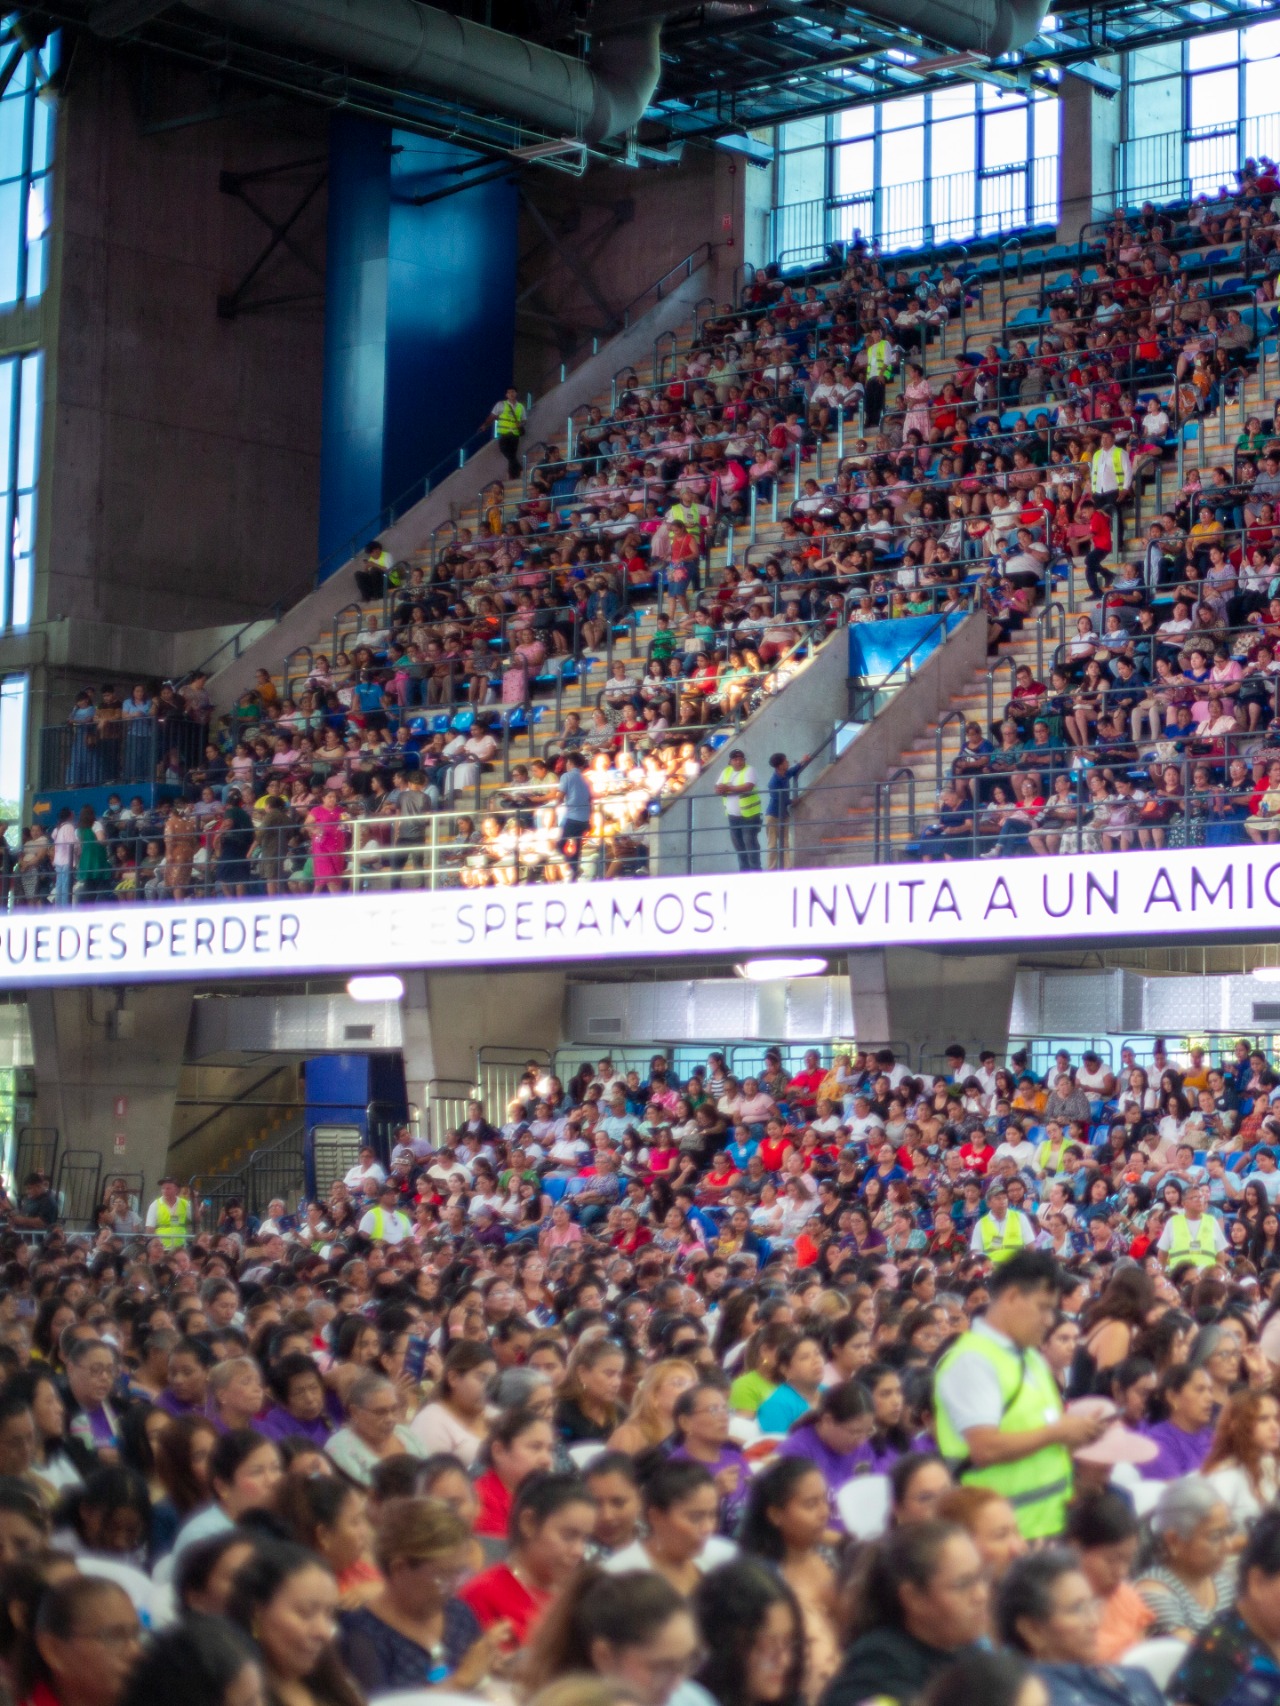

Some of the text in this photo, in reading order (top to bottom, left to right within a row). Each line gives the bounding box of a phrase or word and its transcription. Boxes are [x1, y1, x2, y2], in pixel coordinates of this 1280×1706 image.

[0, 921, 127, 965] UEDES
[143, 913, 301, 958] PERDER
[792, 878, 963, 928] INVITA
[983, 875, 1018, 920] A
[1042, 869, 1119, 918] UN
